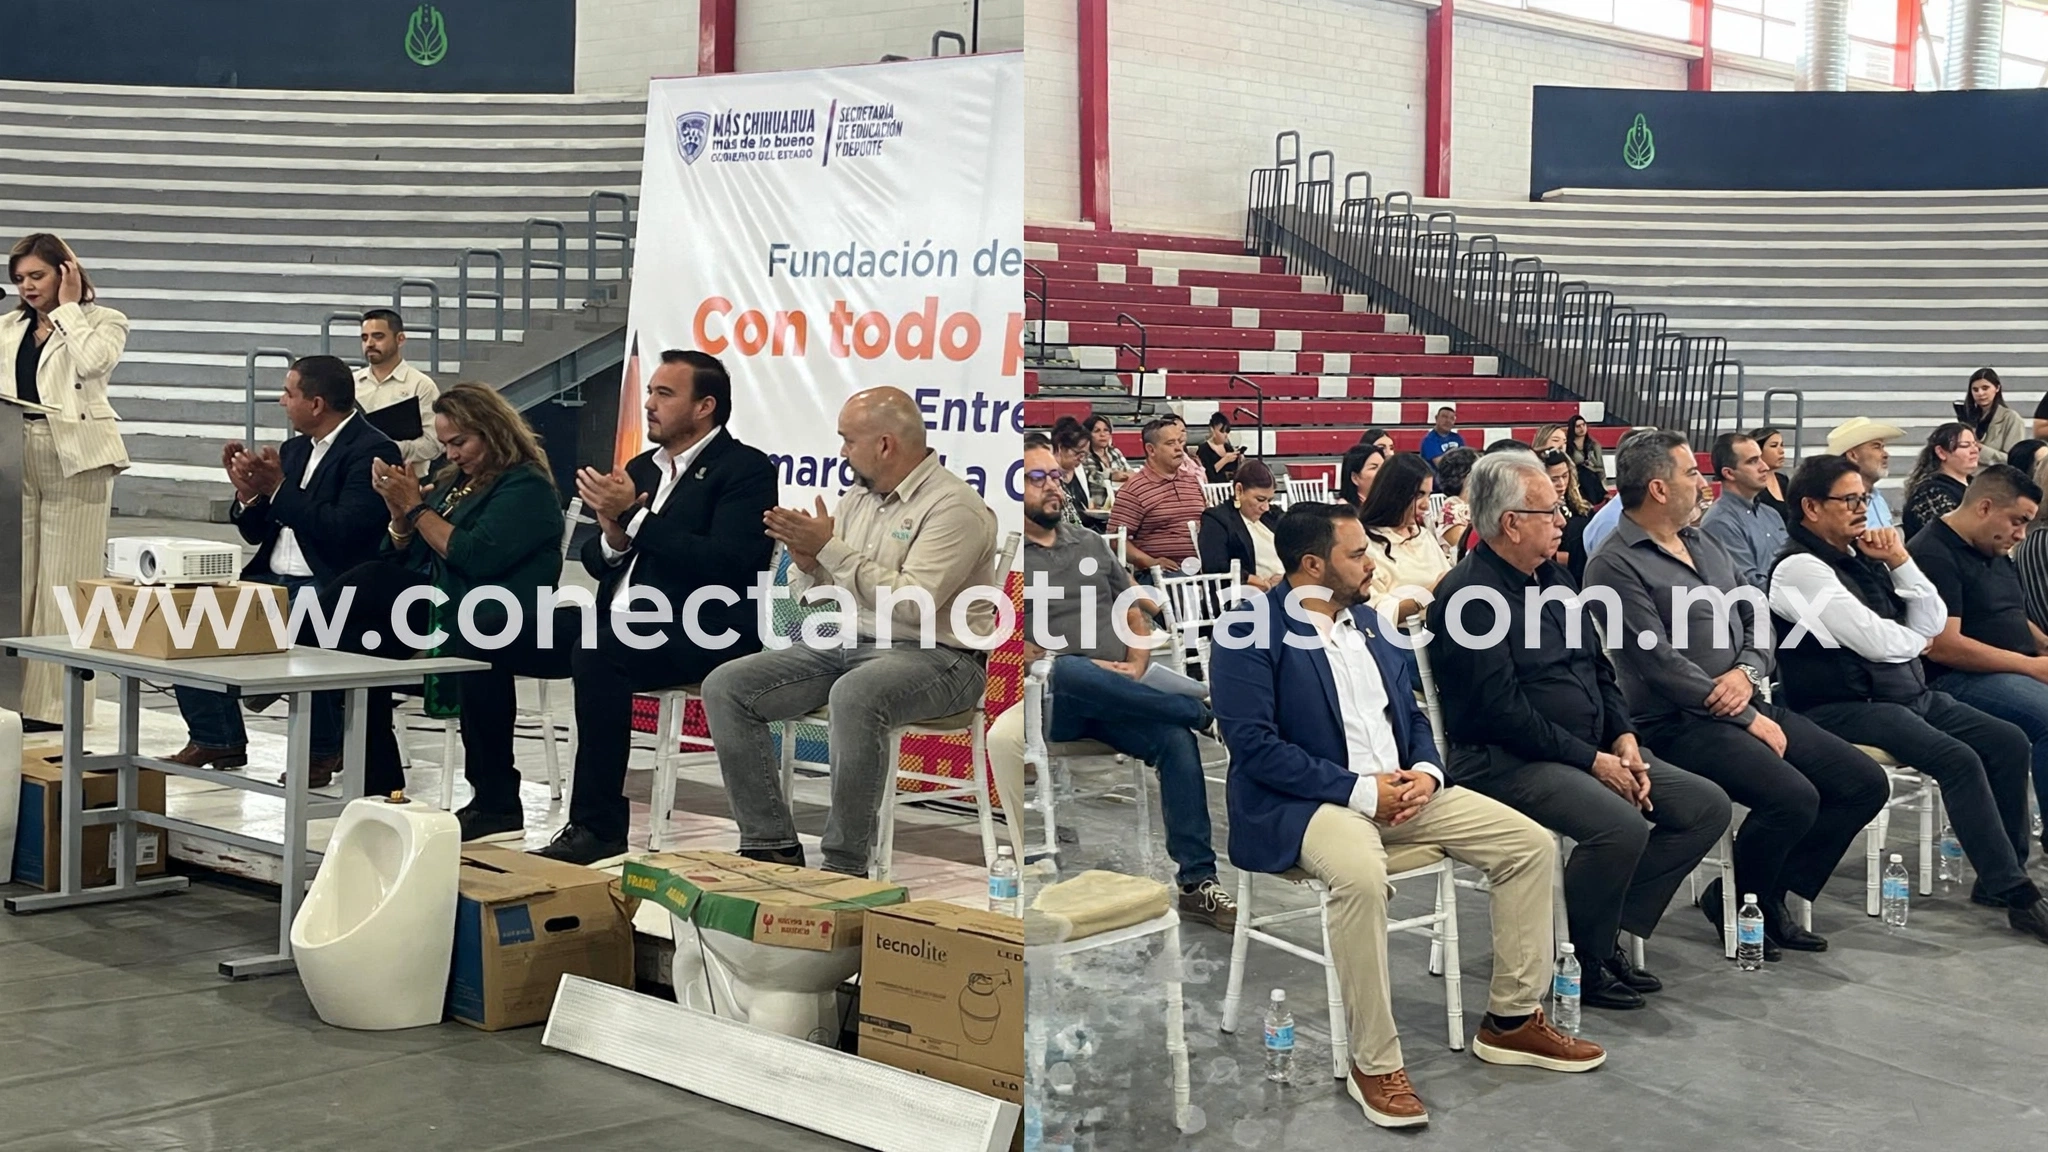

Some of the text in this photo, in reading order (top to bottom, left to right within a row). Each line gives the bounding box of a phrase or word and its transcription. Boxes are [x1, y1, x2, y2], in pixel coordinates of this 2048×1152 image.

[713, 109, 815, 137] MÁS CHIHUAHUA
[837, 120, 904, 141] DE EDUCACIÓN
[713, 135, 814, 150] más de lo bueno
[835, 141, 842, 157] Y
[777, 149, 812, 160] ESTADO
[768, 239, 1022, 277] Fundación de
[693, 296, 807, 356] Con
[829, 296, 982, 361] todo
[876, 933, 948, 962] tecnolite
[997, 949, 1023, 961] LED
